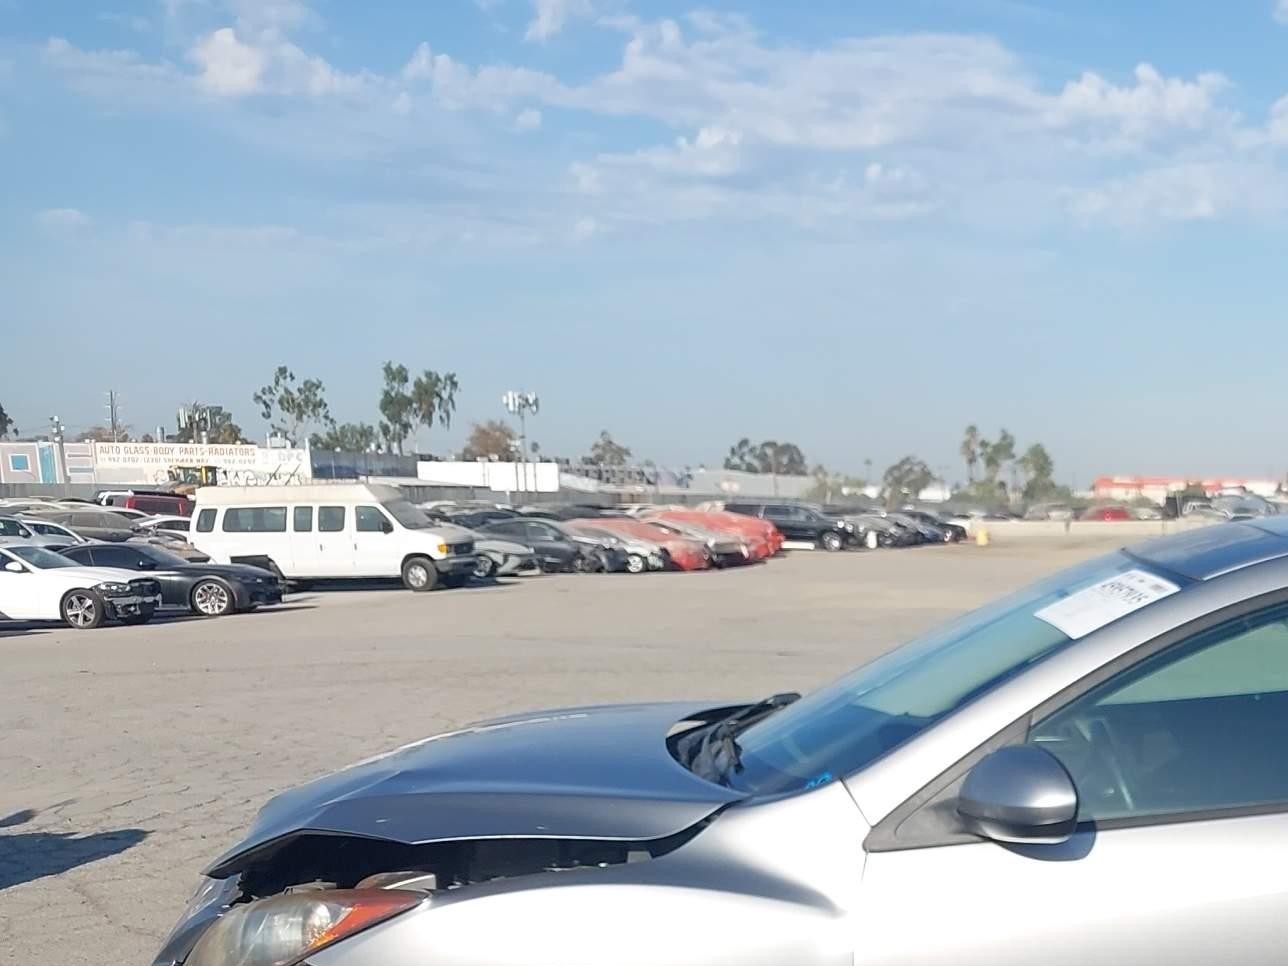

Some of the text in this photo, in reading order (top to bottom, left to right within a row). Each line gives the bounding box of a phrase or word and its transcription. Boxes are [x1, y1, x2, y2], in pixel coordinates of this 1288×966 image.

[99, 445, 121, 455] AUTO
[123, 446, 150, 455] GLASS
[153, 446, 175, 455] BODY
[179, 446, 205, 456] PARTS
[208, 447, 256, 457] RADIATORS
